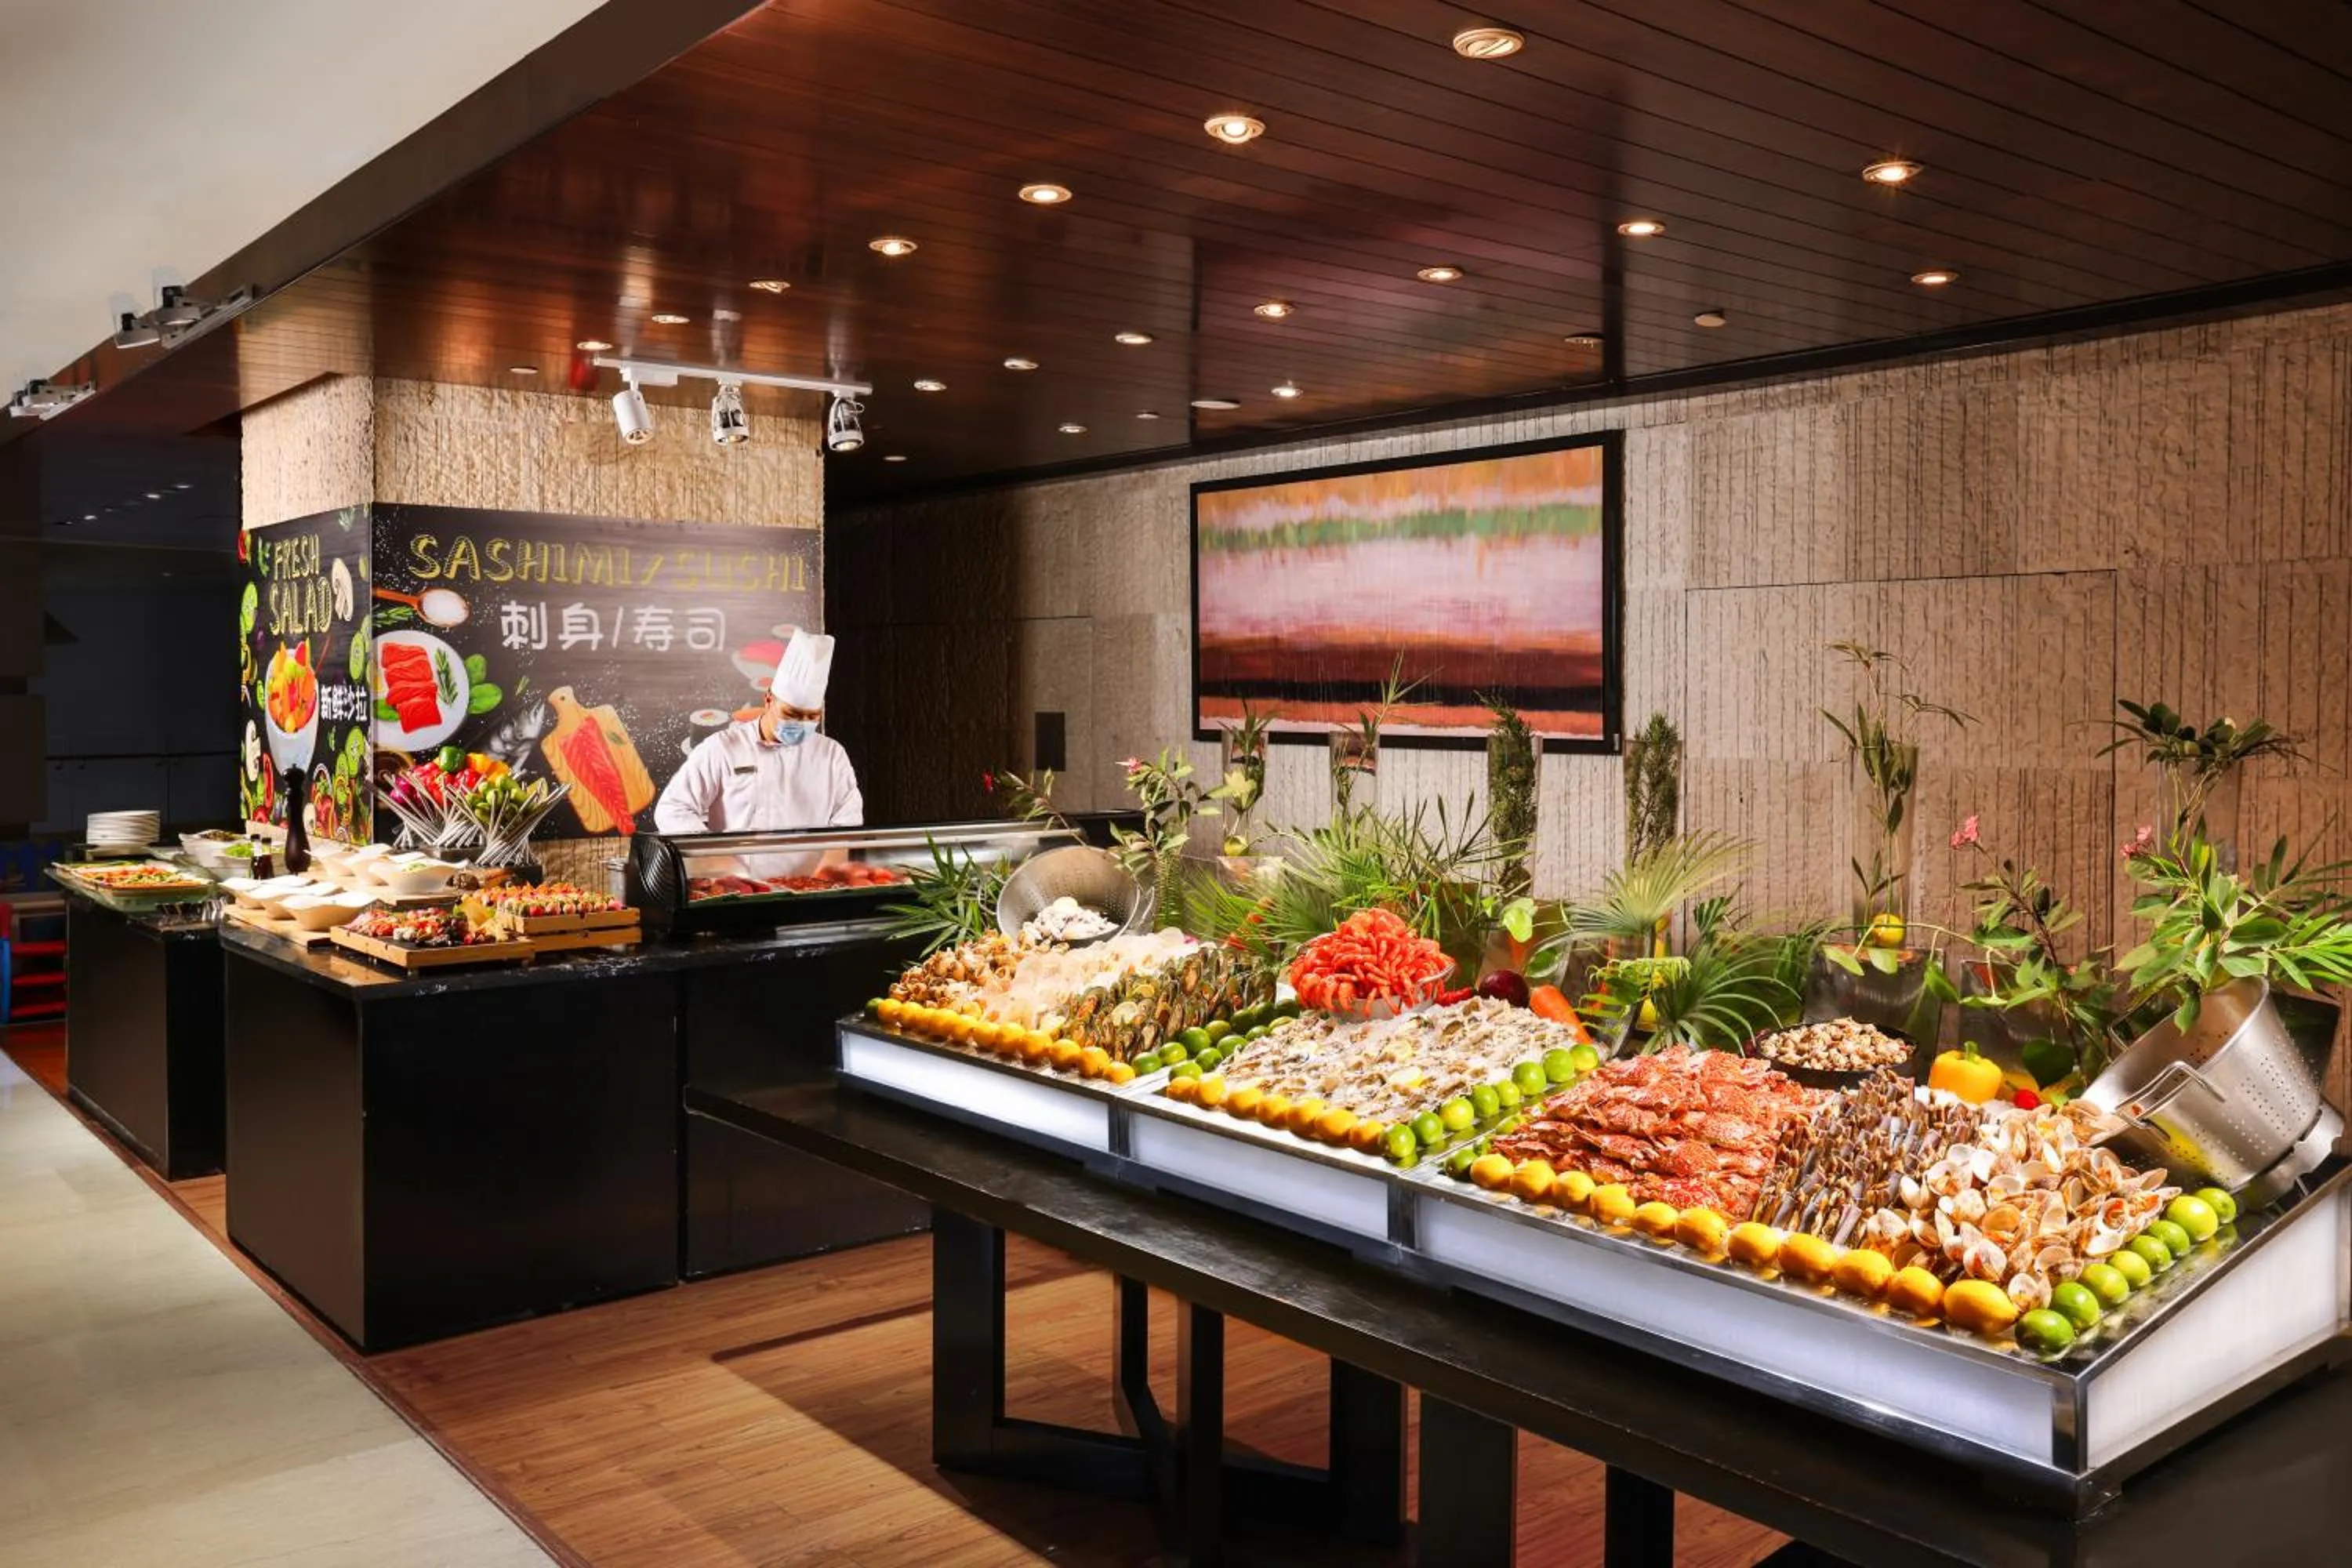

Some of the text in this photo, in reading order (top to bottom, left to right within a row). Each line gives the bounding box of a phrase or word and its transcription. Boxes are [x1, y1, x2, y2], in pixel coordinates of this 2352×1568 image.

[274, 533, 320, 580] FRESH
[269, 576, 332, 636] SALAD
[500, 600, 726, 652] 刺身/寿司
[321, 684, 368, 721] 新鲜沙拉
